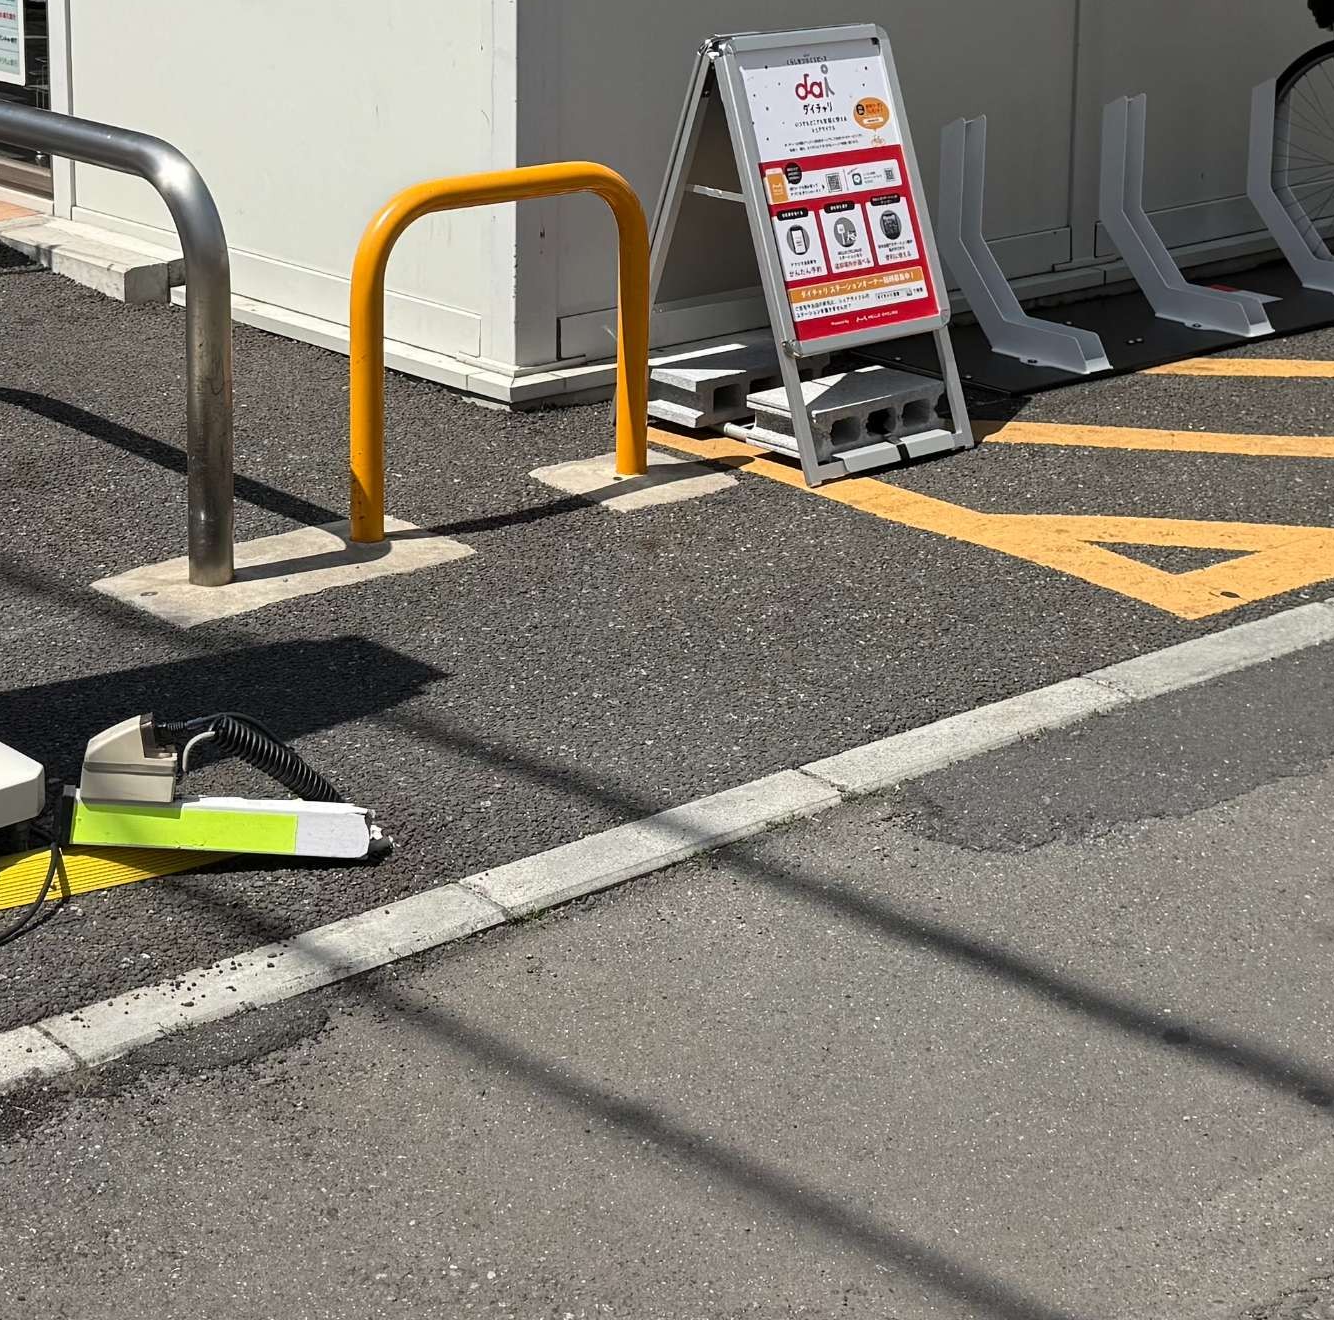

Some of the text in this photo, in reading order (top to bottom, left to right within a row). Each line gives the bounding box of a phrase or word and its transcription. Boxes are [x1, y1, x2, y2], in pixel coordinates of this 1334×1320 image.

[795, 64, 835, 101] dai
[803, 102, 833, 116] ダイチャリ
